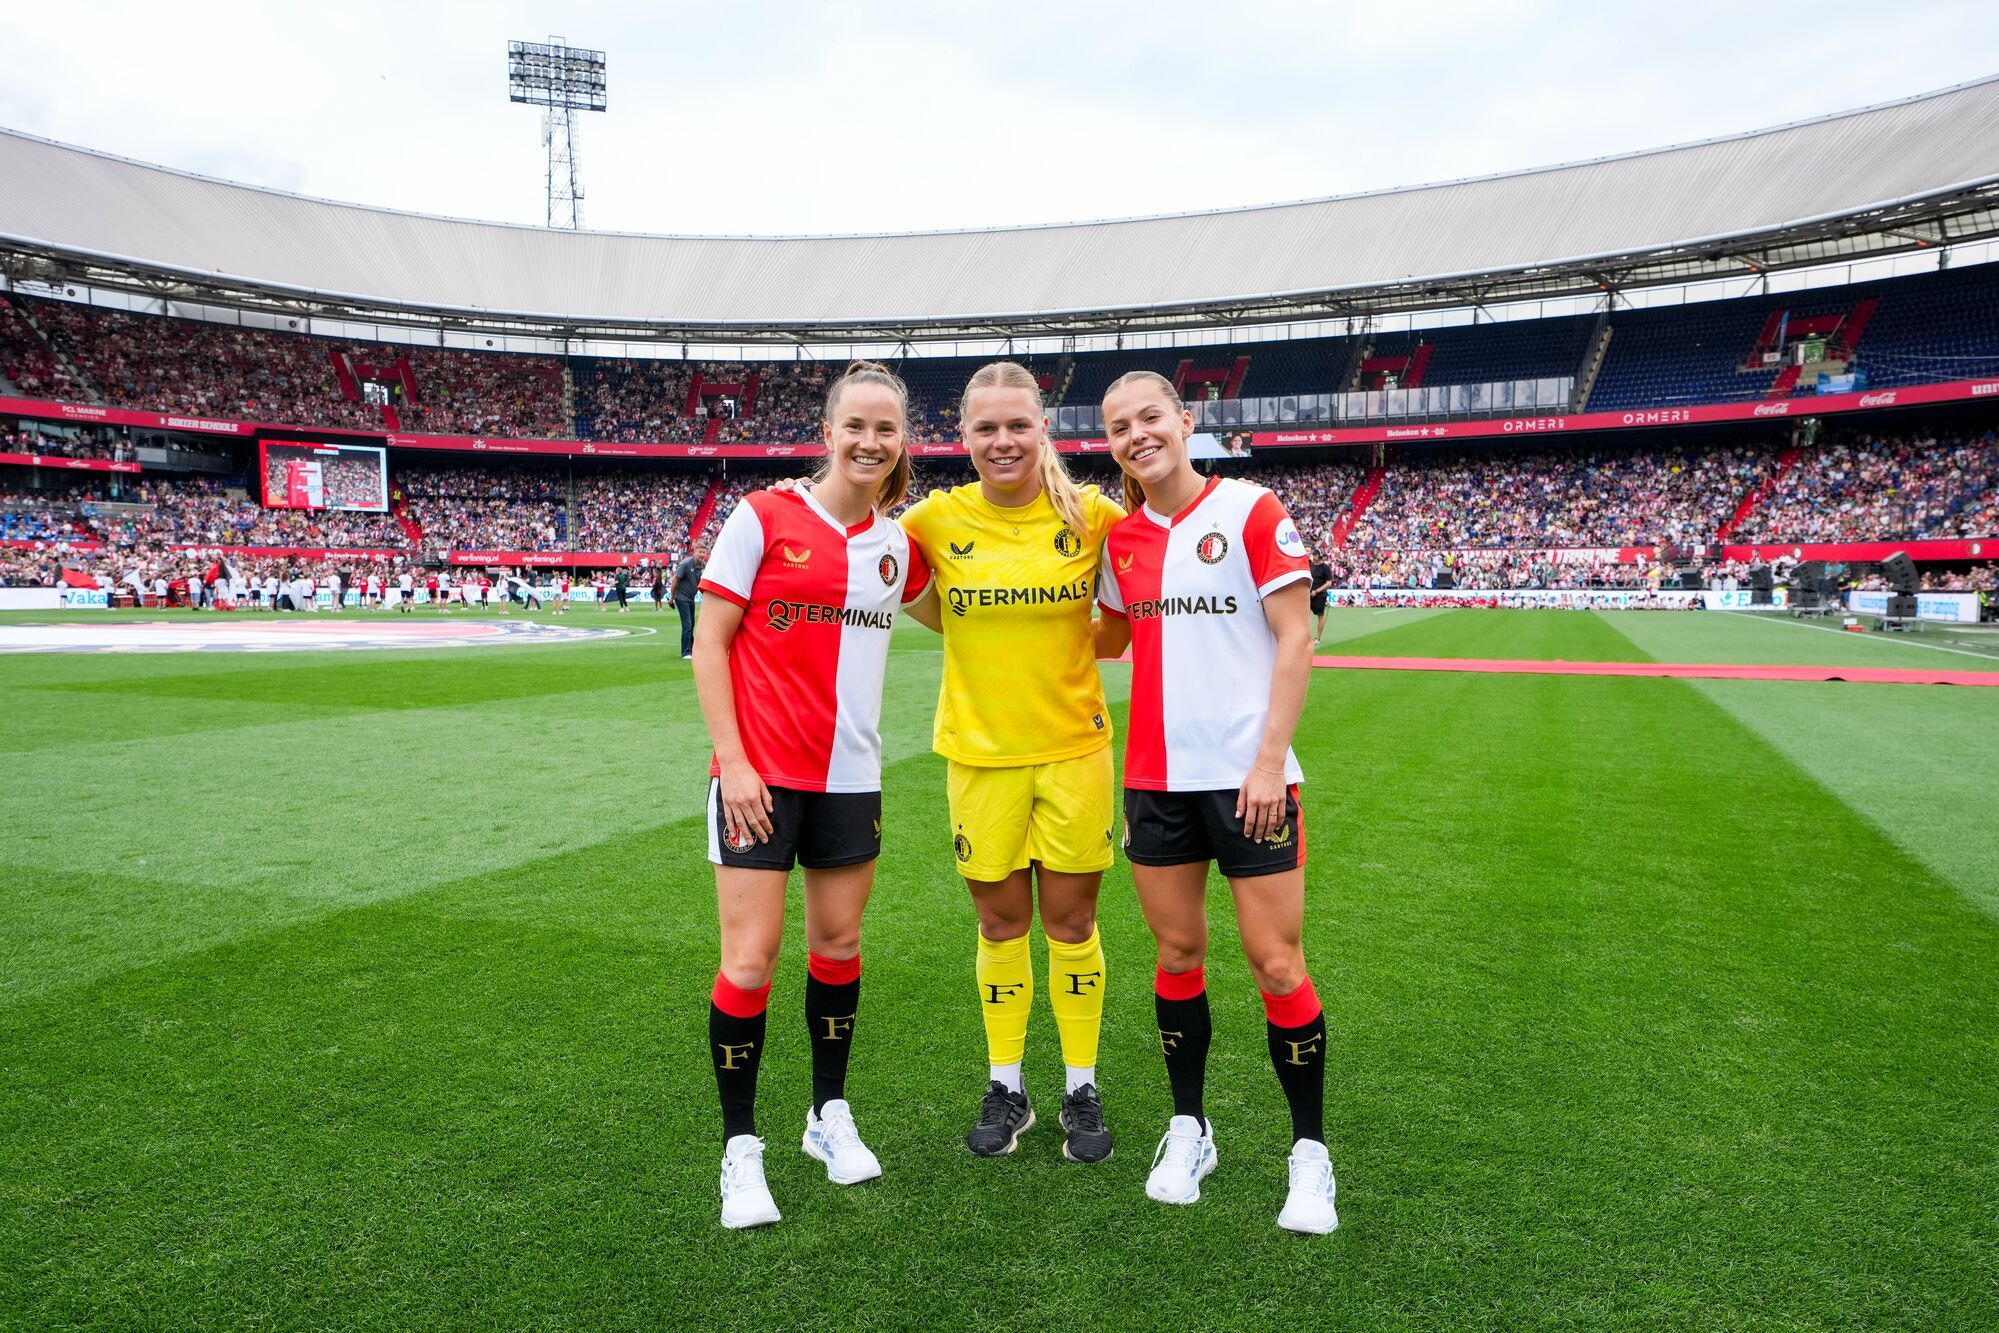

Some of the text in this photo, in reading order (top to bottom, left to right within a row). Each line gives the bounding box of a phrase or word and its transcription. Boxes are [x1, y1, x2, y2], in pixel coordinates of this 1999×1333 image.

[1859, 392, 1897, 407] Coca-Cola
[62, 405, 107, 416] FCL MARINE
[1753, 402, 1790, 415] Coca-Cola
[1623, 410, 1680, 424] ORMER
[168, 417, 239, 432] SOCCER SCHOOLS
[1503, 419, 1556, 432] ORMER
[1277, 434, 1308, 442] Heineken
[1387, 429, 1420, 437] Heineken
[457, 553, 499, 563] verloning.nl
[521, 554, 563, 564] verloning.nl
[783, 562, 809, 570] CASTORE
[66, 591, 108, 605] Vaka
[948, 580, 1088, 617] QTERMINALS
[1126, 596, 1237, 620] TERMINALS
[765, 599, 892, 632] QTERMINALS
[1270, 841, 1292, 850] CASTORE
[1065, 971, 1101, 996] F
[984, 983, 1024, 1004] F
[821, 1013, 855, 1040] F
[718, 1041, 754, 1070] F
[1285, 1032, 1322, 1065] F
